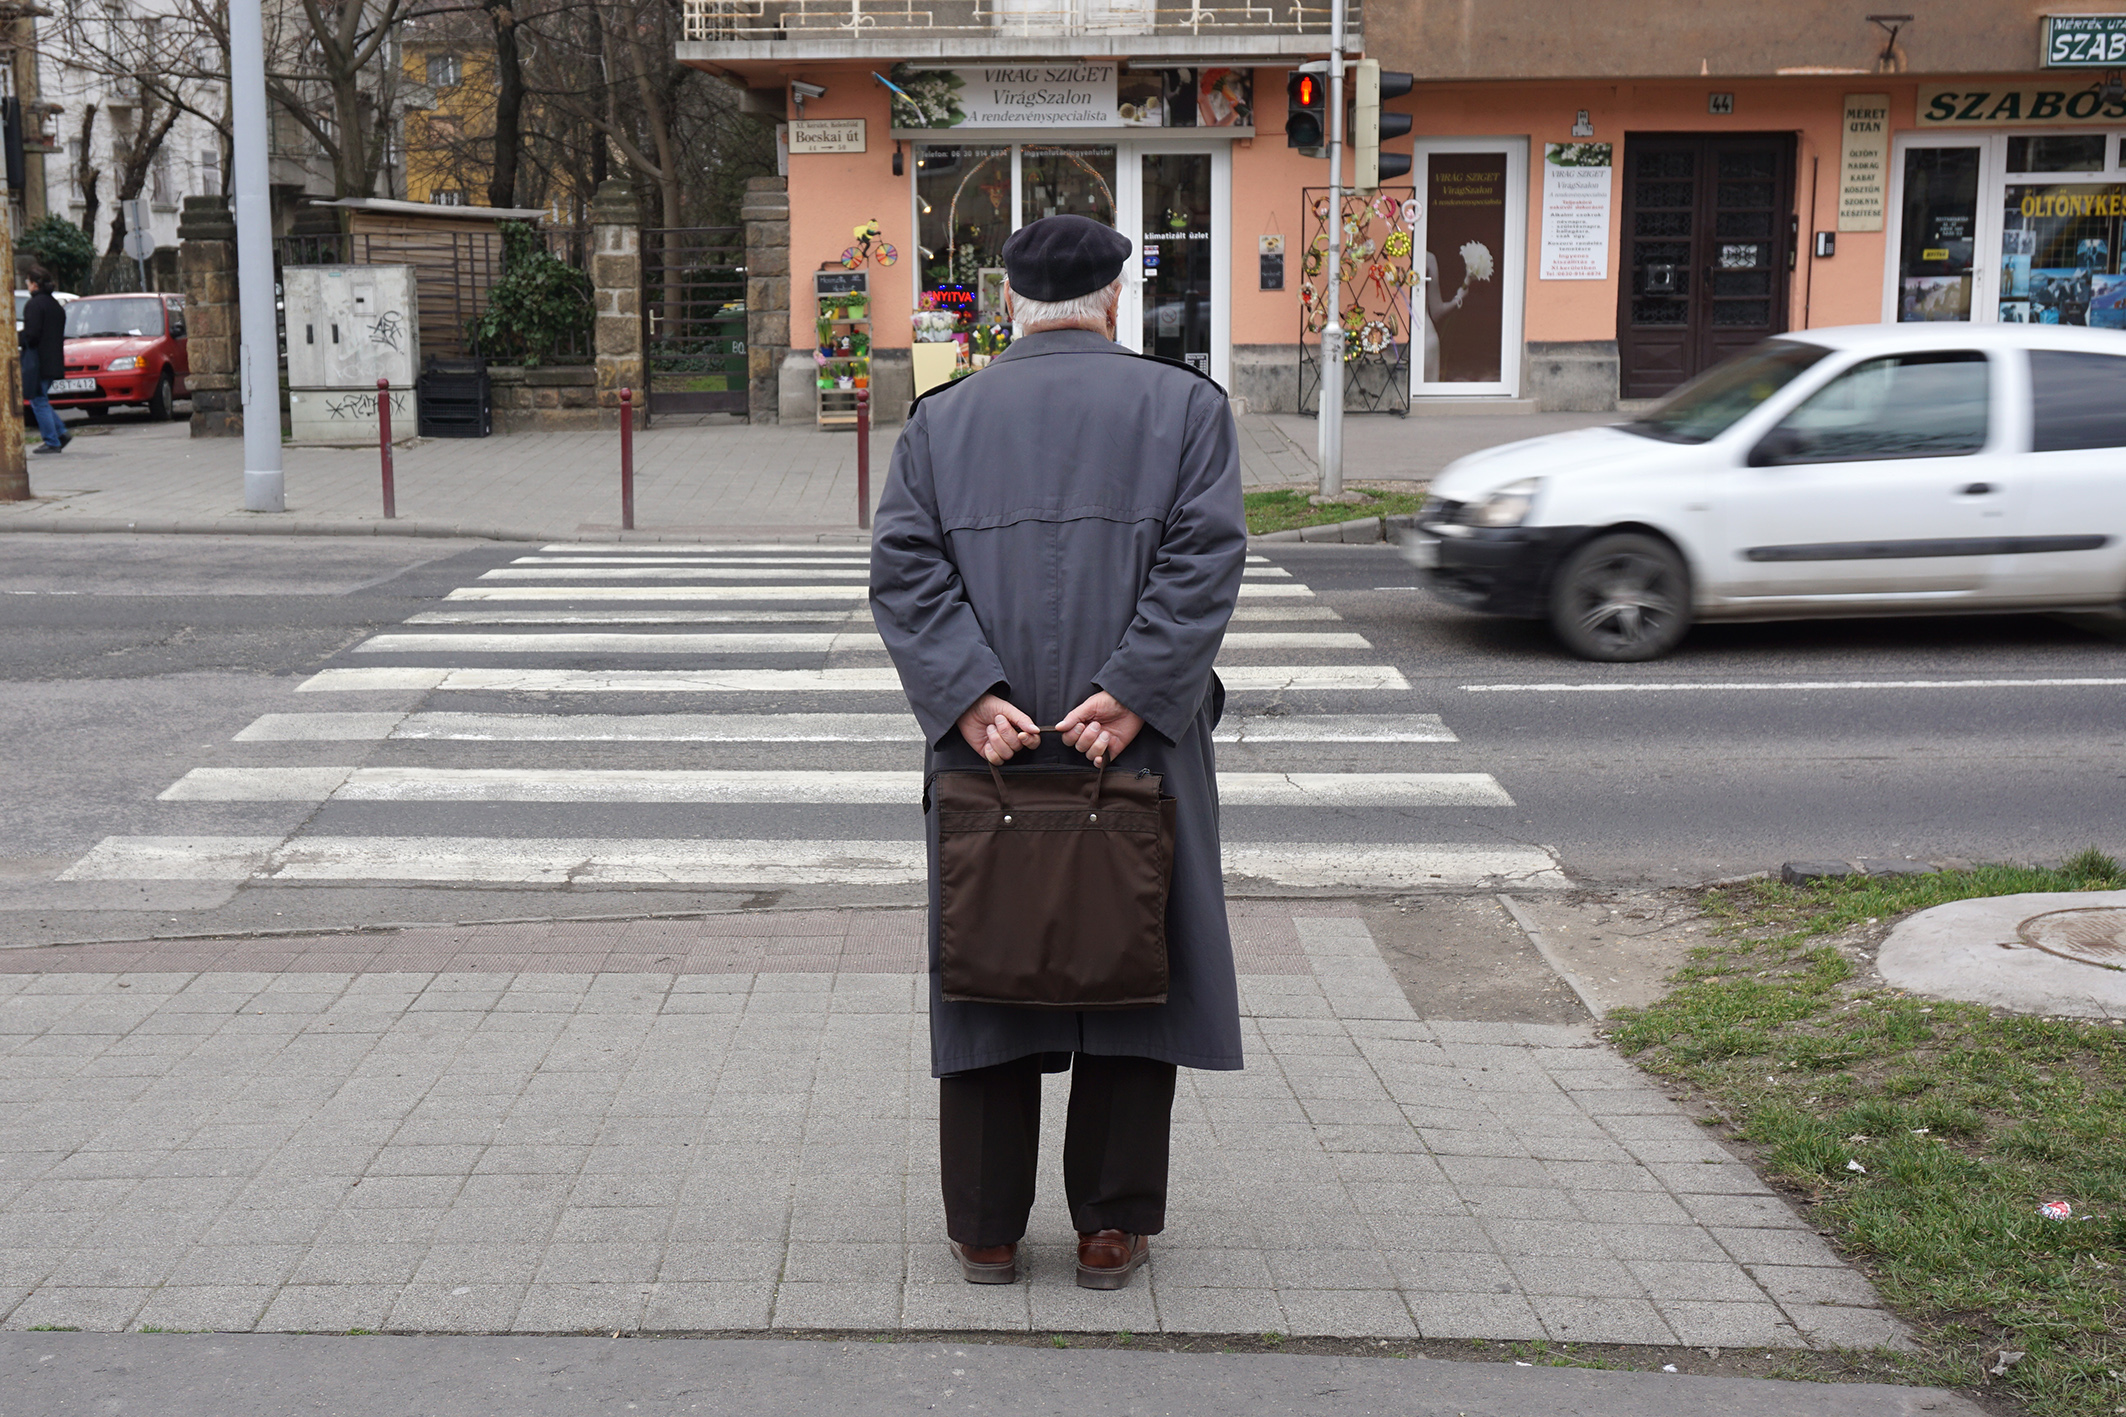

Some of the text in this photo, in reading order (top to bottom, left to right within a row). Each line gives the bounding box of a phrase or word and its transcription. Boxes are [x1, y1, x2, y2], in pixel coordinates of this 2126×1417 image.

[1044, 66, 1113, 82] SZIGET
[994, 89, 1092, 108] VirágSzalon
[1712, 95, 1730, 111] 44
[968, 110, 1107, 123] A rendezvényspecialista
[796, 129, 859, 143] Bocskai út
[1577, 170, 1606, 178] SZIGET
[1144, 231, 1209, 240] klimatizált üzlet
[932, 291, 973, 302] NYITVA
